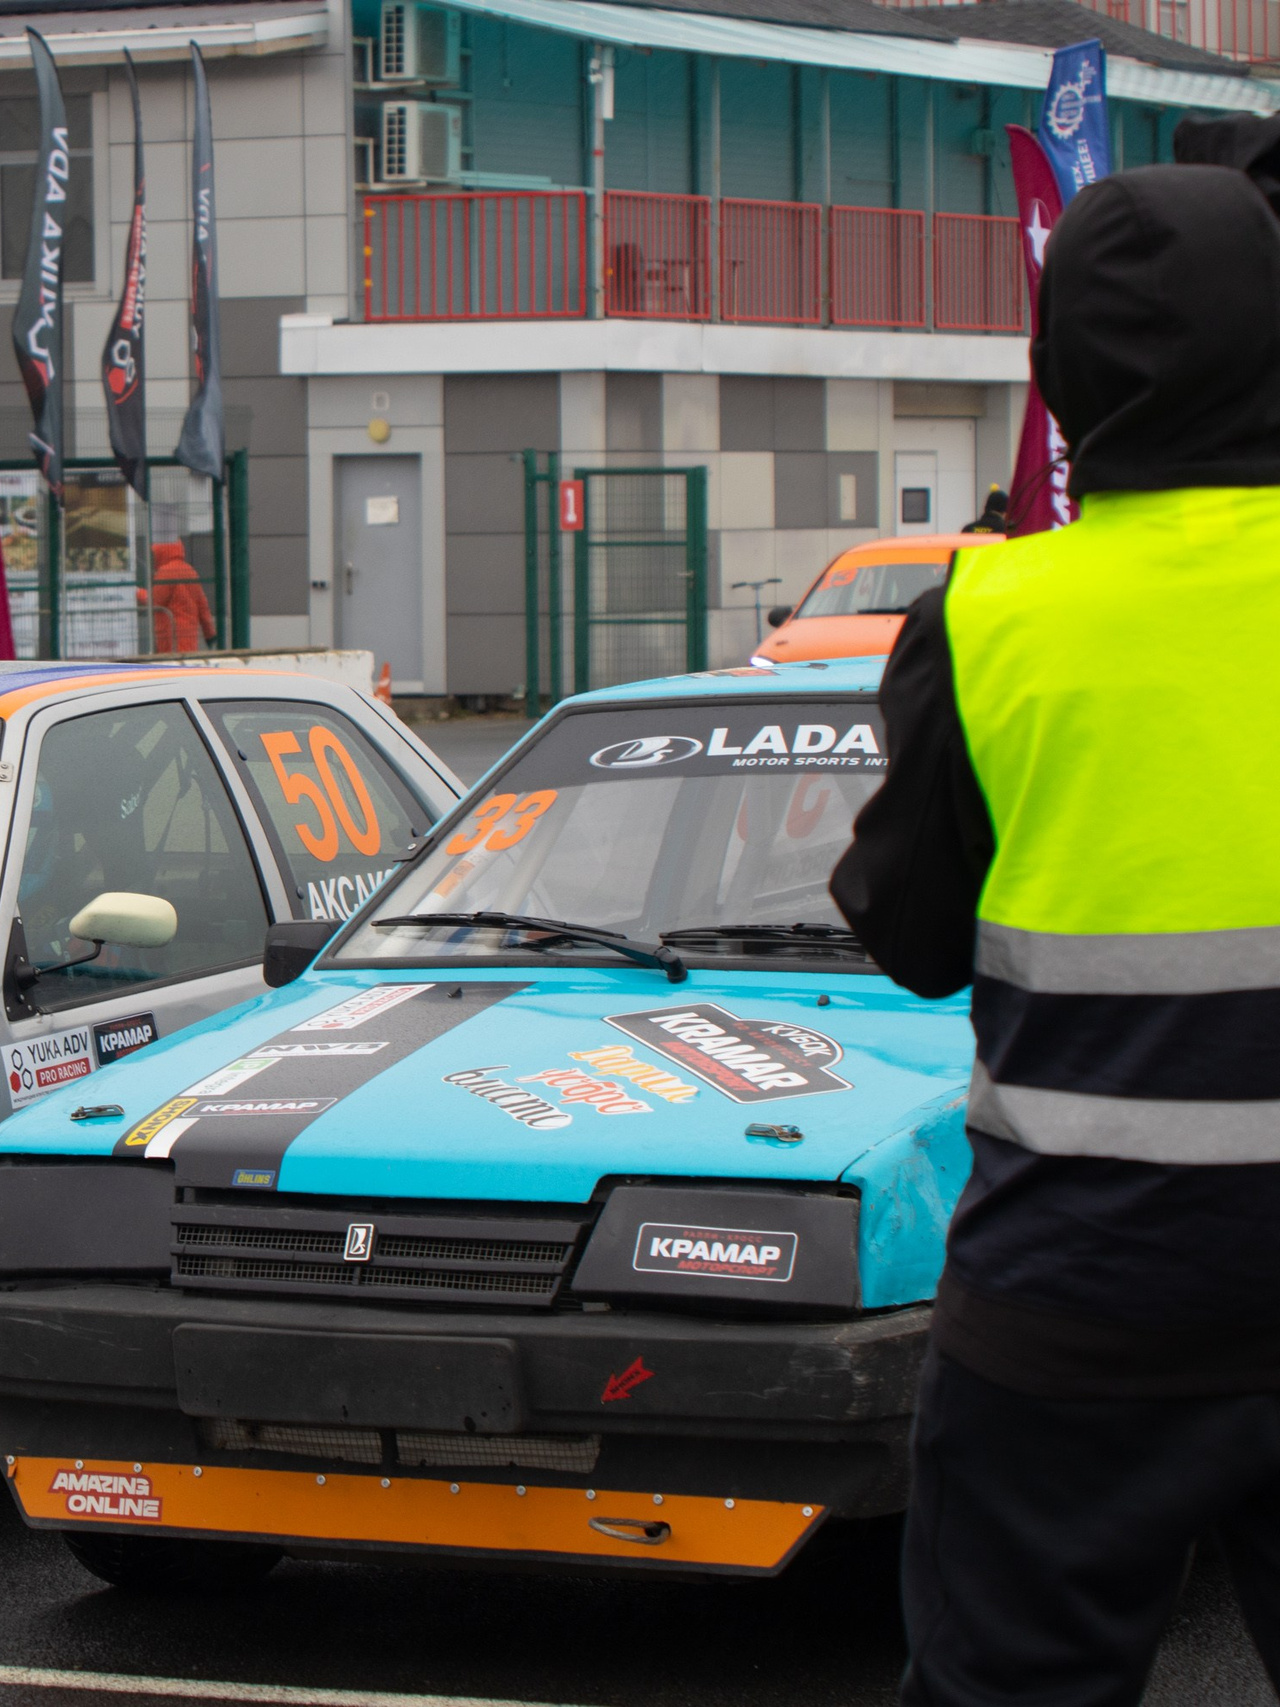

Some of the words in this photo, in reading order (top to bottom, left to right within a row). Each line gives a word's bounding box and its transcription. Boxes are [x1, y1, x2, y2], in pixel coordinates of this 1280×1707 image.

[566, 488, 577, 523] 1
[706, 723, 880, 757] LADA
[731, 757, 790, 768] MOTOR
[793, 756, 861, 767] SPORTS
[259, 725, 382, 863] 50
[445, 789, 559, 856] 33
[307, 868, 394, 922] АКСАК
[27, 1038, 65, 1064] YUKA
[63, 1031, 88, 1057] ADV
[100, 1024, 153, 1053] КРАМАР
[648, 1012, 810, 1091] KRAMAR
[761, 1024, 833, 1057] КУБОК
[39, 1069, 57, 1085] PRO
[58, 1061, 88, 1080] RACING
[200, 1101, 319, 1112] КРАМАР
[237, 1171, 271, 1184] ÖHLINS
[649, 1236, 781, 1266] КРАМАР
[677, 1260, 778, 1276] МОТОРСПОРТ
[52, 1472, 150, 1496] AMAZING
[67, 1494, 160, 1518] ONLINE
